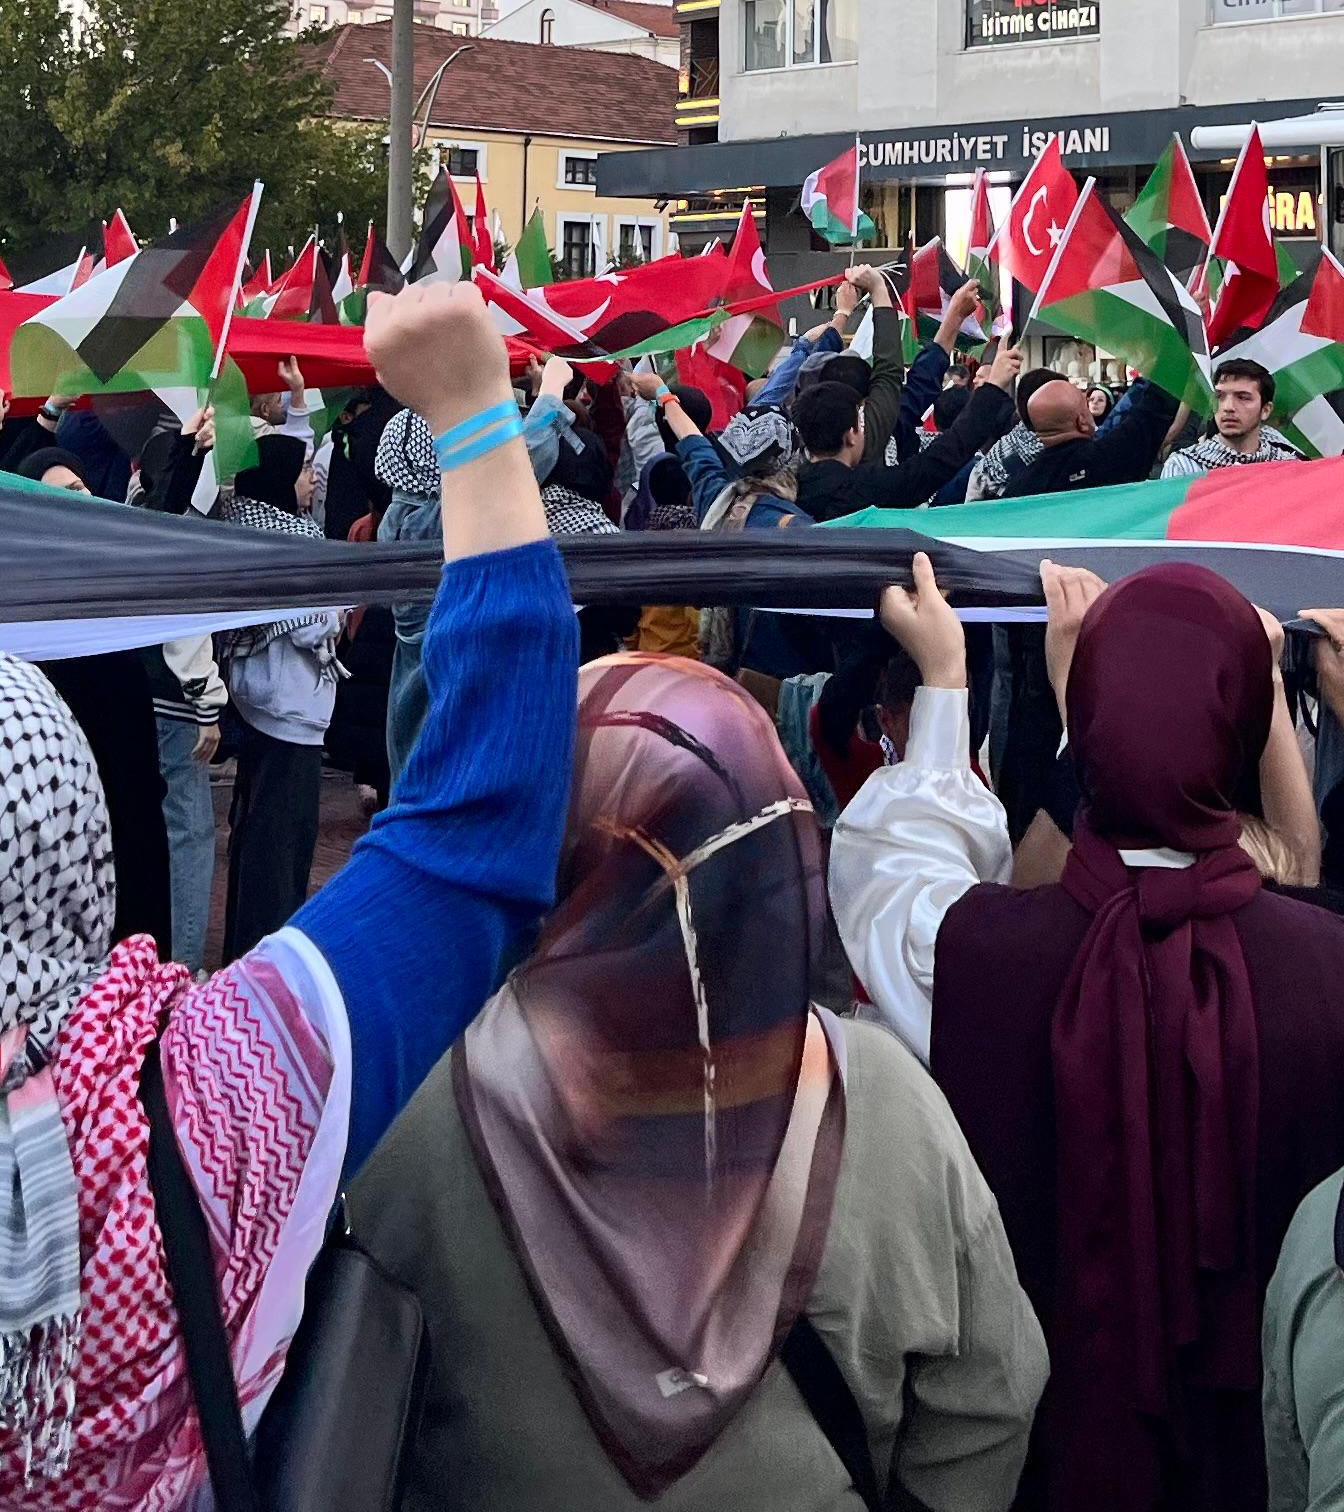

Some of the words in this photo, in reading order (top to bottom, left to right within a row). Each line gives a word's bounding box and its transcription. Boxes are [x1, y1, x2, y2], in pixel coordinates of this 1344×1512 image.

[982, 11, 1034, 41] İŞİTME
[1037, 5, 1096, 31] CİHAZI
[857, 131, 1008, 166] CUMHURİYET
